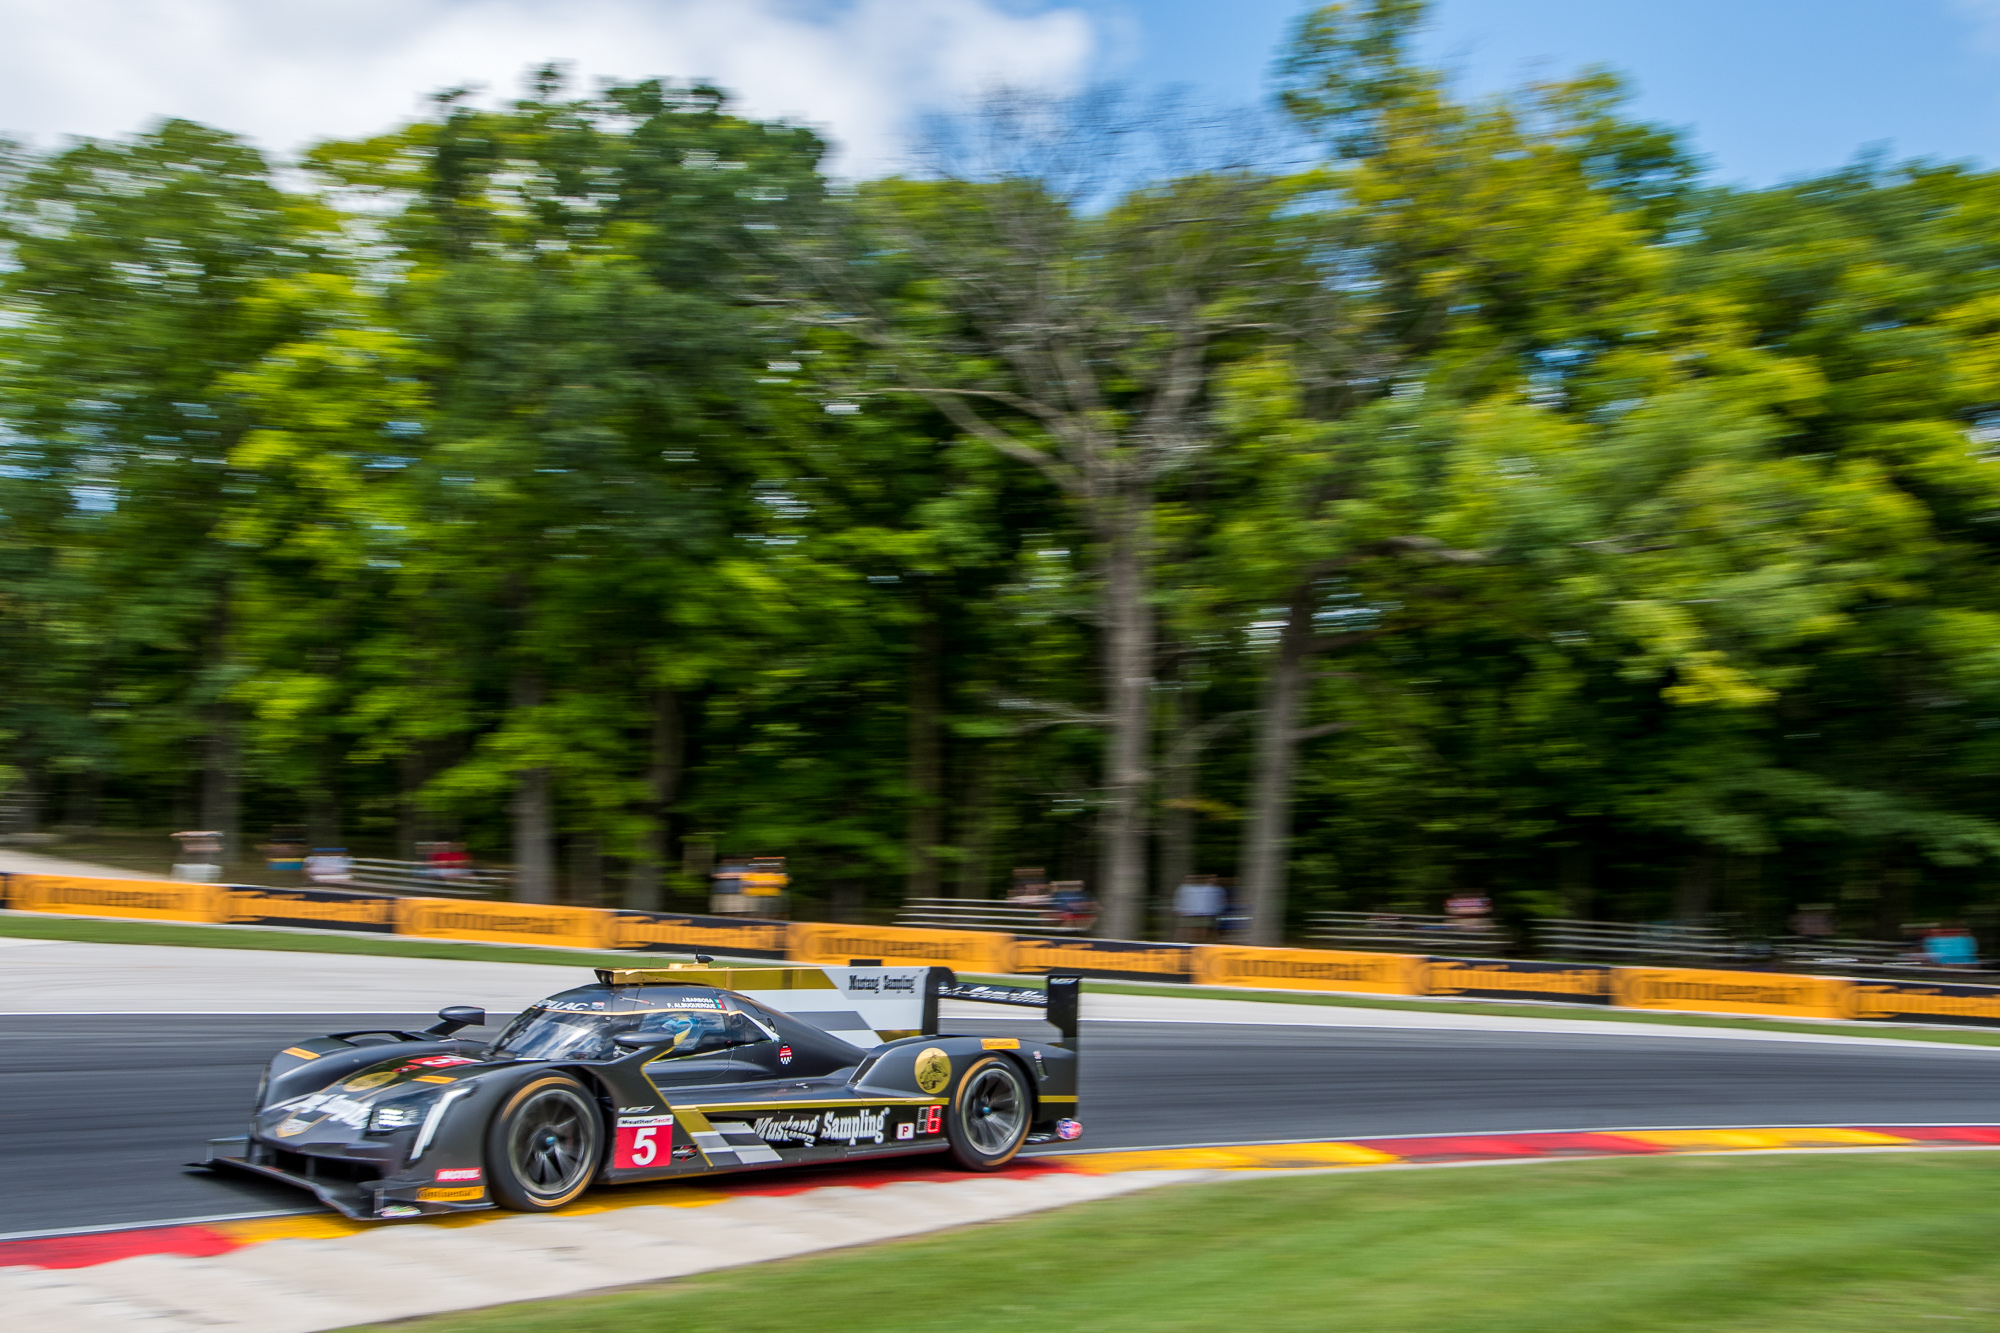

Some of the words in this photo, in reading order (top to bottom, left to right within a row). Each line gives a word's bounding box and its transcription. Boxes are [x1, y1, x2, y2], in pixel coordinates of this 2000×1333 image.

[631, 1127, 657, 1166] 5
[753, 1115, 820, 1147] Mustang
[820, 1108, 885, 1146] Sampling
[902, 1124, 910, 1137] P
